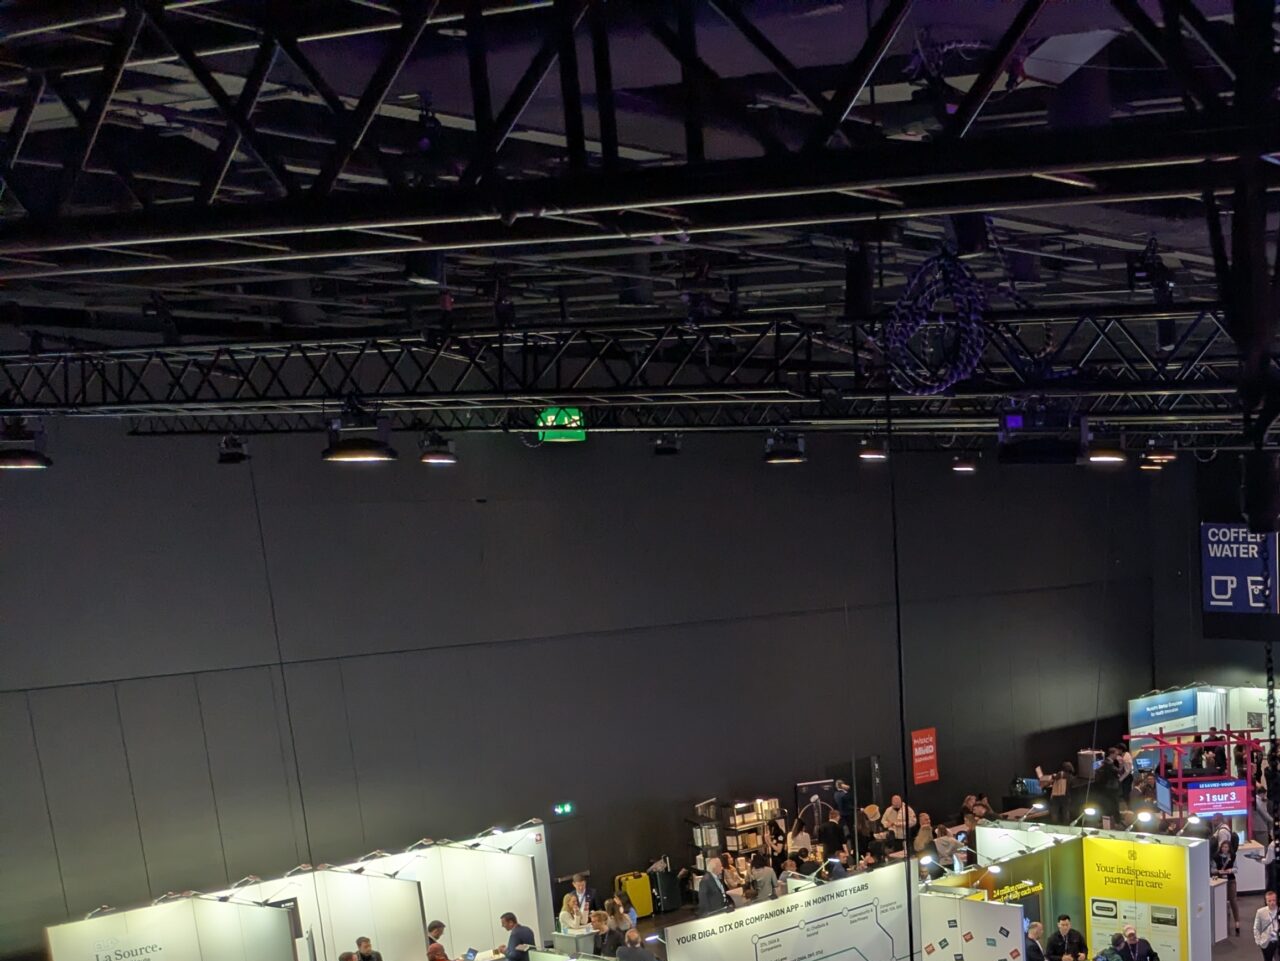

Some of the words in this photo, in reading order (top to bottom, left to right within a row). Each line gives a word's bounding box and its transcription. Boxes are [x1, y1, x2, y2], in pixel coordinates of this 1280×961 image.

[1208, 544, 1259, 558] WATER
[1206, 794, 1210, 802] 1
[1230, 792, 1236, 800] 3
[1096, 862, 1114, 873] Your
[1116, 864, 1172, 880] indispensable
[1104, 876, 1135, 886] partner
[1145, 881, 1164, 889] care
[676, 934, 697, 945] YOUR
[718, 923, 733, 934] DTX
[734, 920, 744, 930] OR
[746, 909, 785, 926] COMPANION
[786, 904, 799, 914] APP
[804, 900, 812, 908] IN
[812, 895, 835, 906] MONTH
[836, 890, 848, 900] NOT
[849, 883, 869, 896] YEARS
[114, 944, 162, 961] Source.
